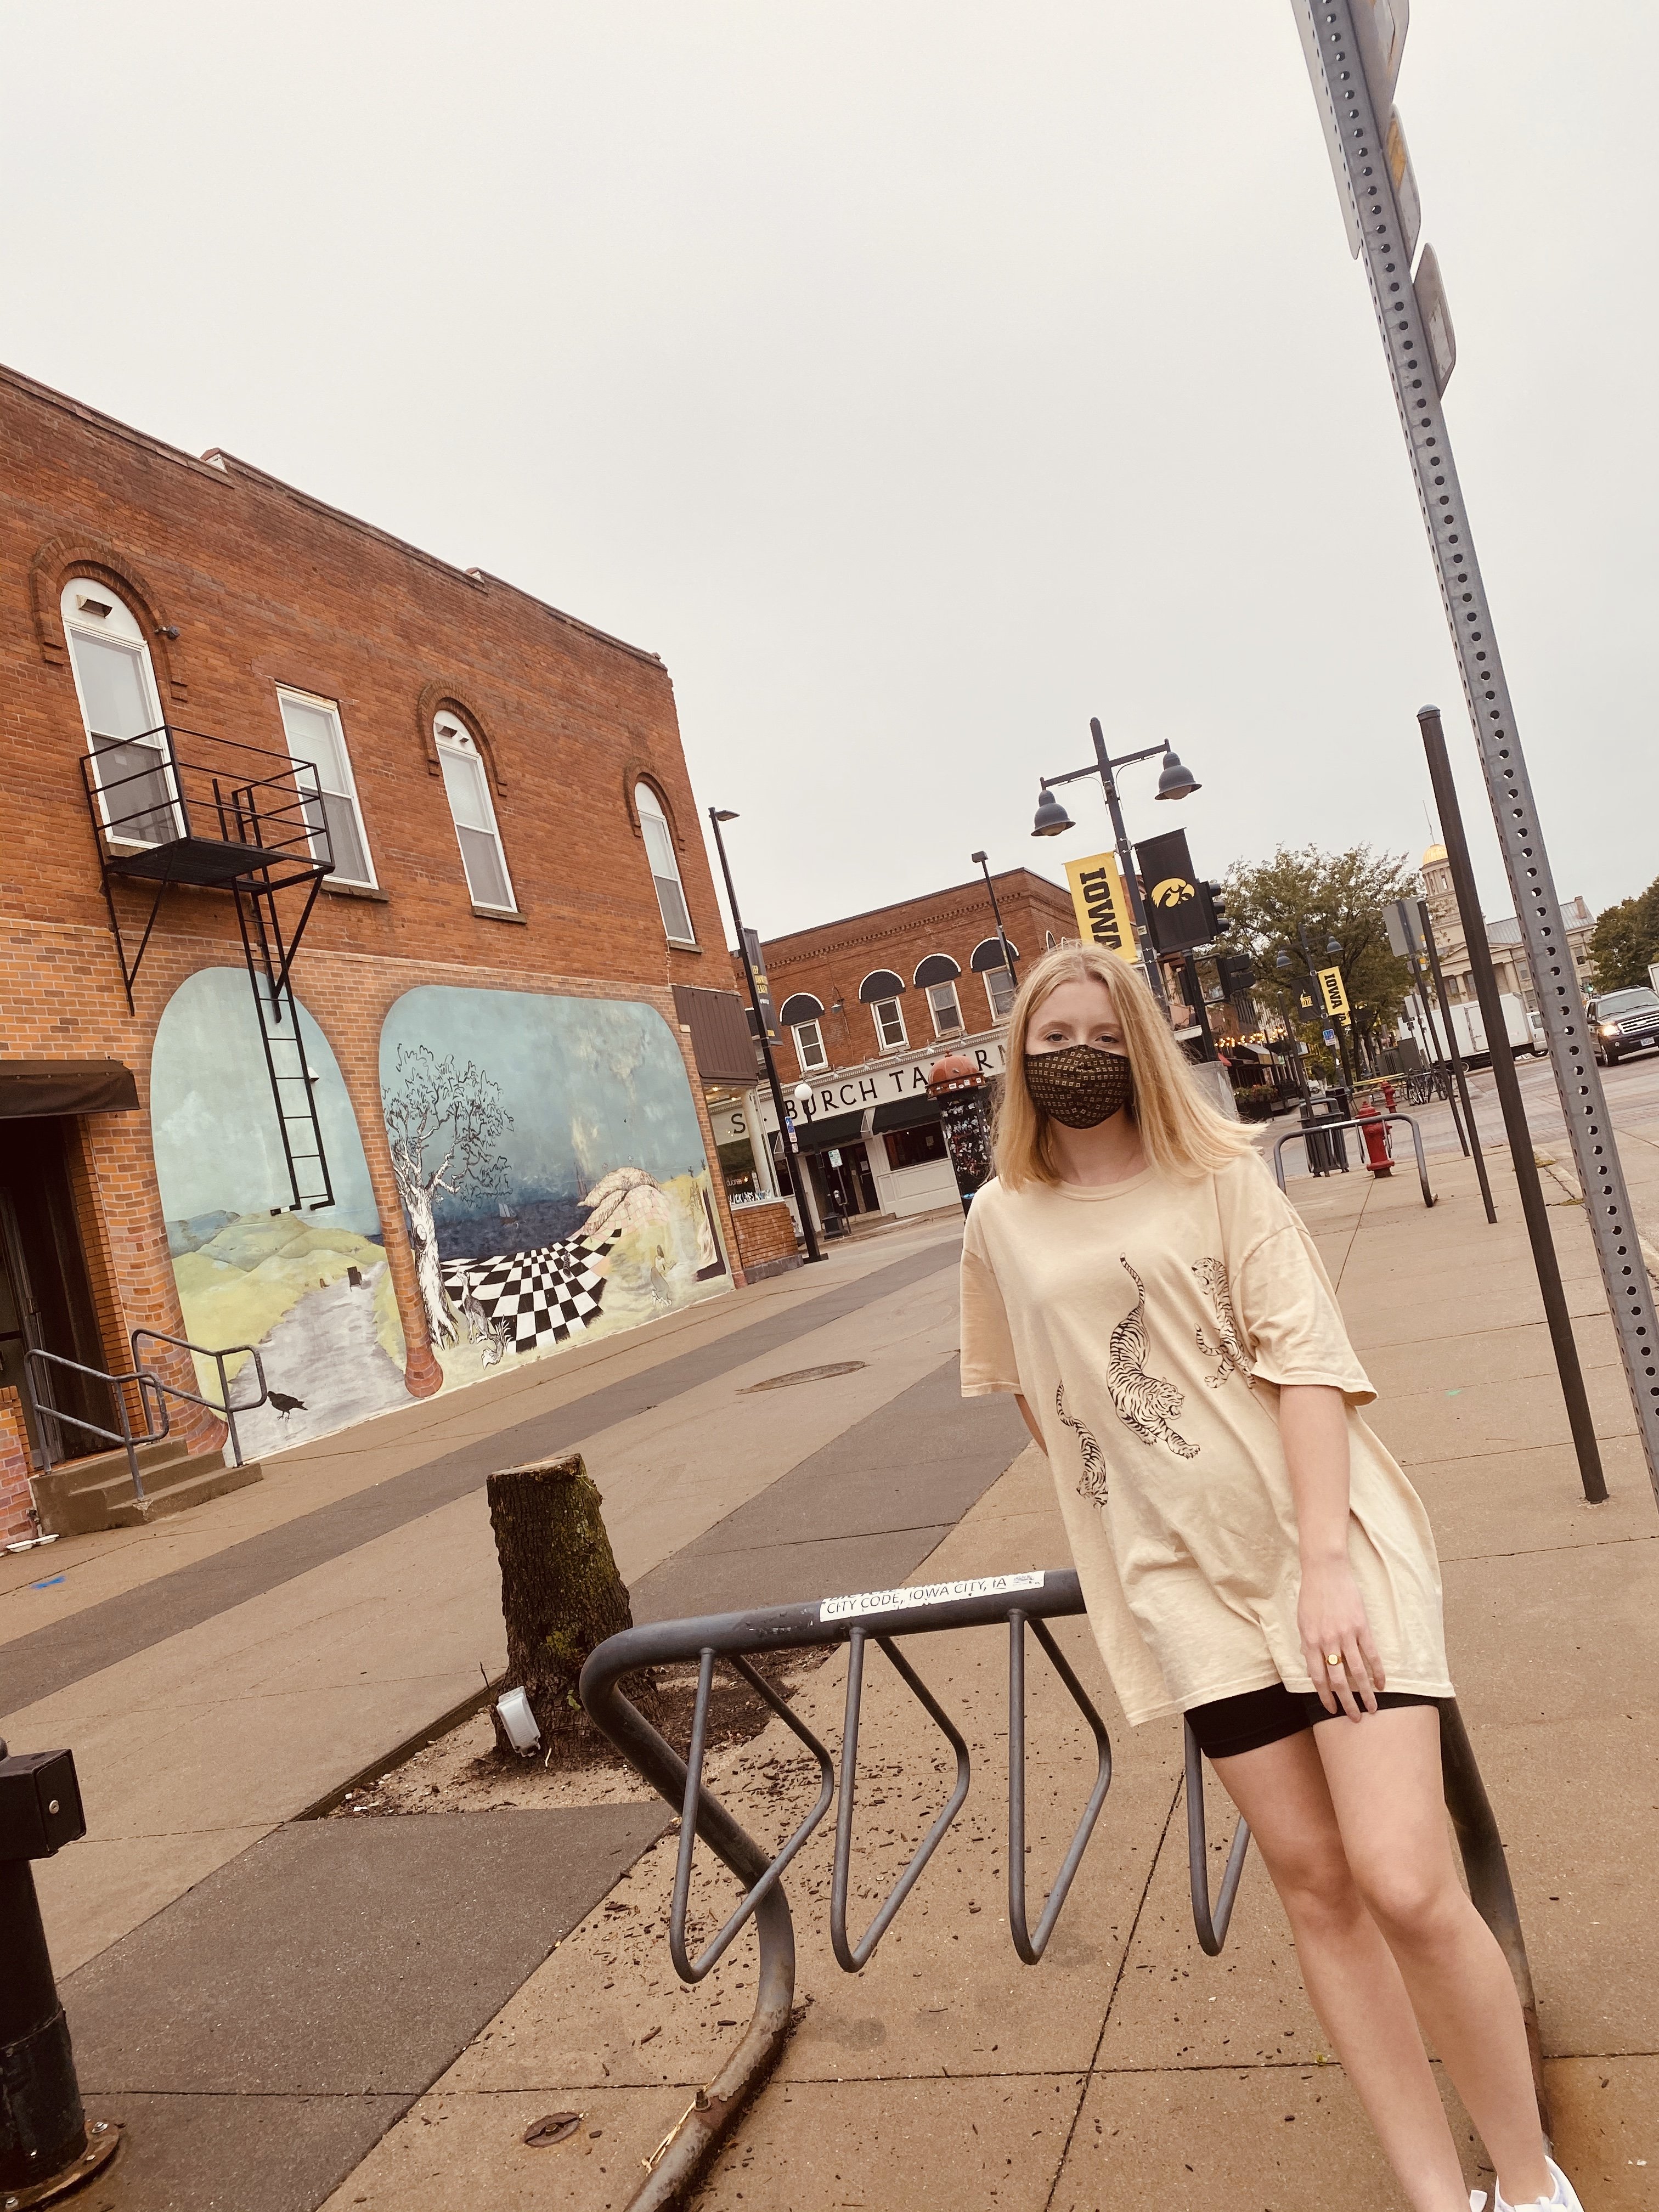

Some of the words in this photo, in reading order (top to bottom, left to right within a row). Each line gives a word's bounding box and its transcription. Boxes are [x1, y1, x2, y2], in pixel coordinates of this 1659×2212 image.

[1080, 867, 1122, 951] IOWA
[1324, 973, 1343, 1009] IOWA
[785, 1077, 879, 1120] BURCH
[889, 1045, 1008, 1092] TAR
[827, 1599, 857, 1613] CITY
[861, 1593, 904, 1608] CODE,
[910, 1586, 949, 1601] IOWA
[955, 1580, 986, 1593] CITY,
[992, 1578, 1007, 1588] IA
